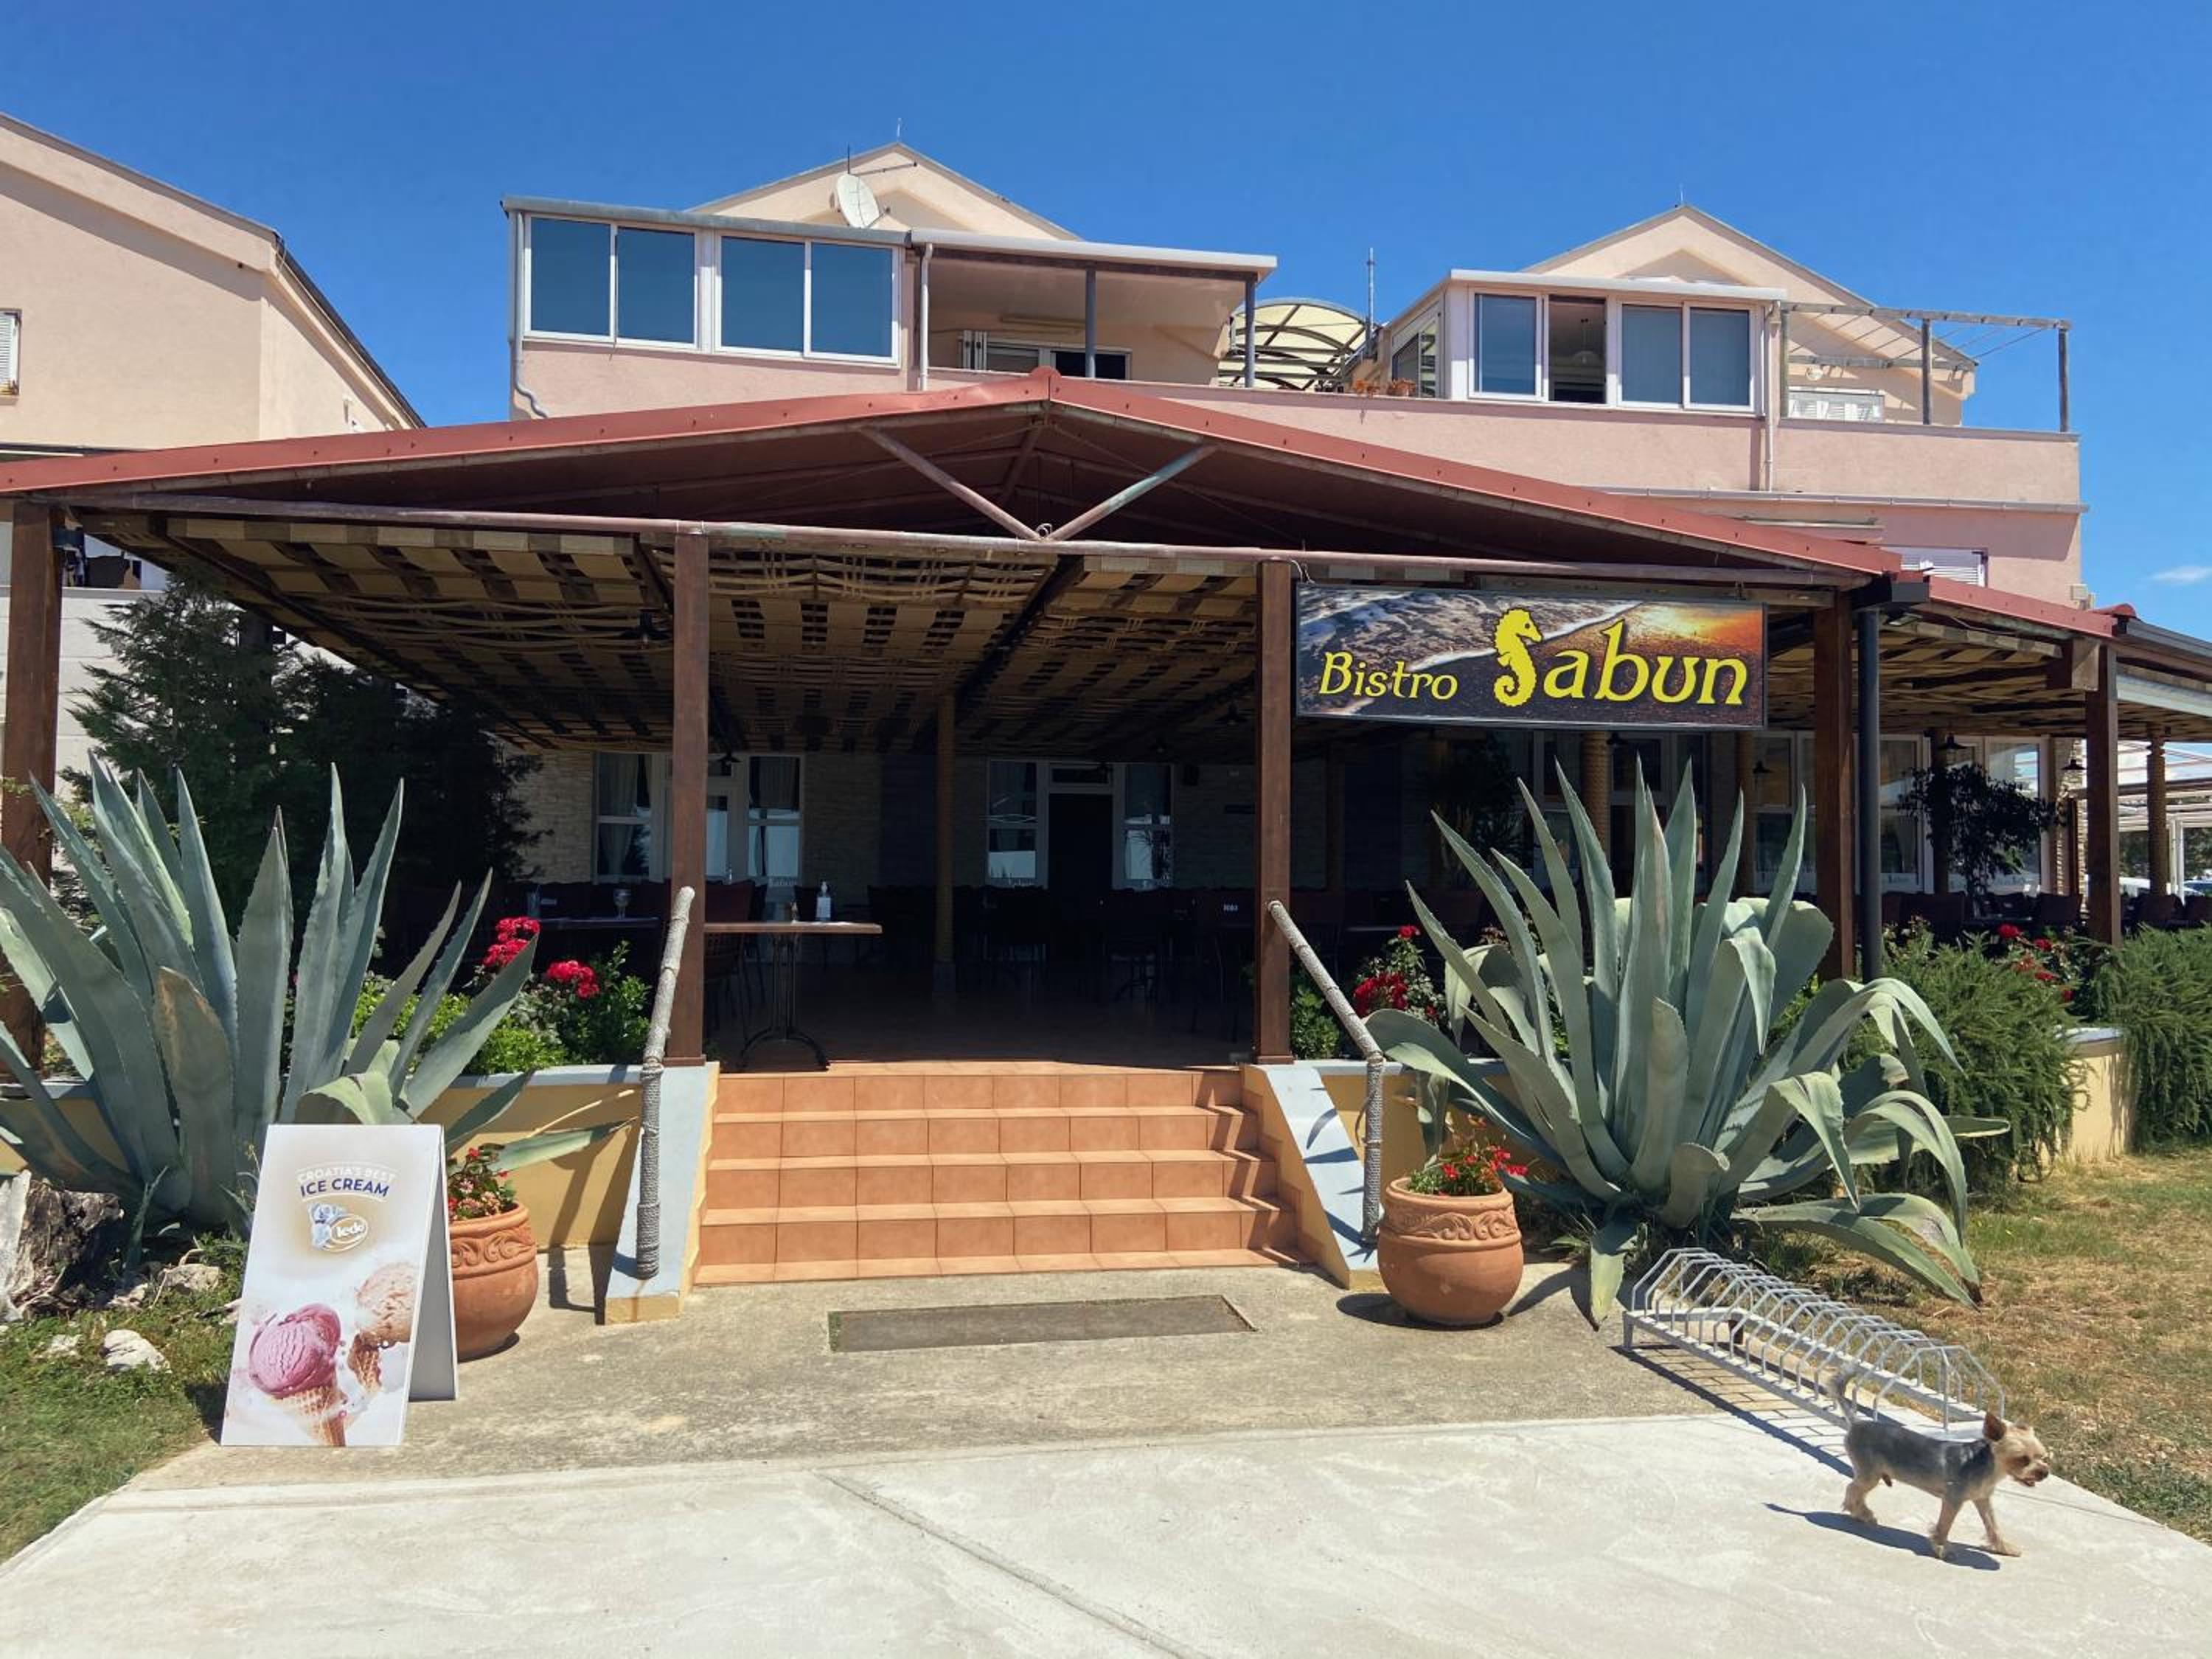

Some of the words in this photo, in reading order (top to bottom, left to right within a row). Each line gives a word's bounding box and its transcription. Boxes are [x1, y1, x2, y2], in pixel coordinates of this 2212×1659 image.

[1319, 651, 1458, 700] Bistro
[366, 1167, 396, 1183] BEST
[300, 1180, 327, 1197] ICE
[332, 1178, 389, 1197] CREAM
